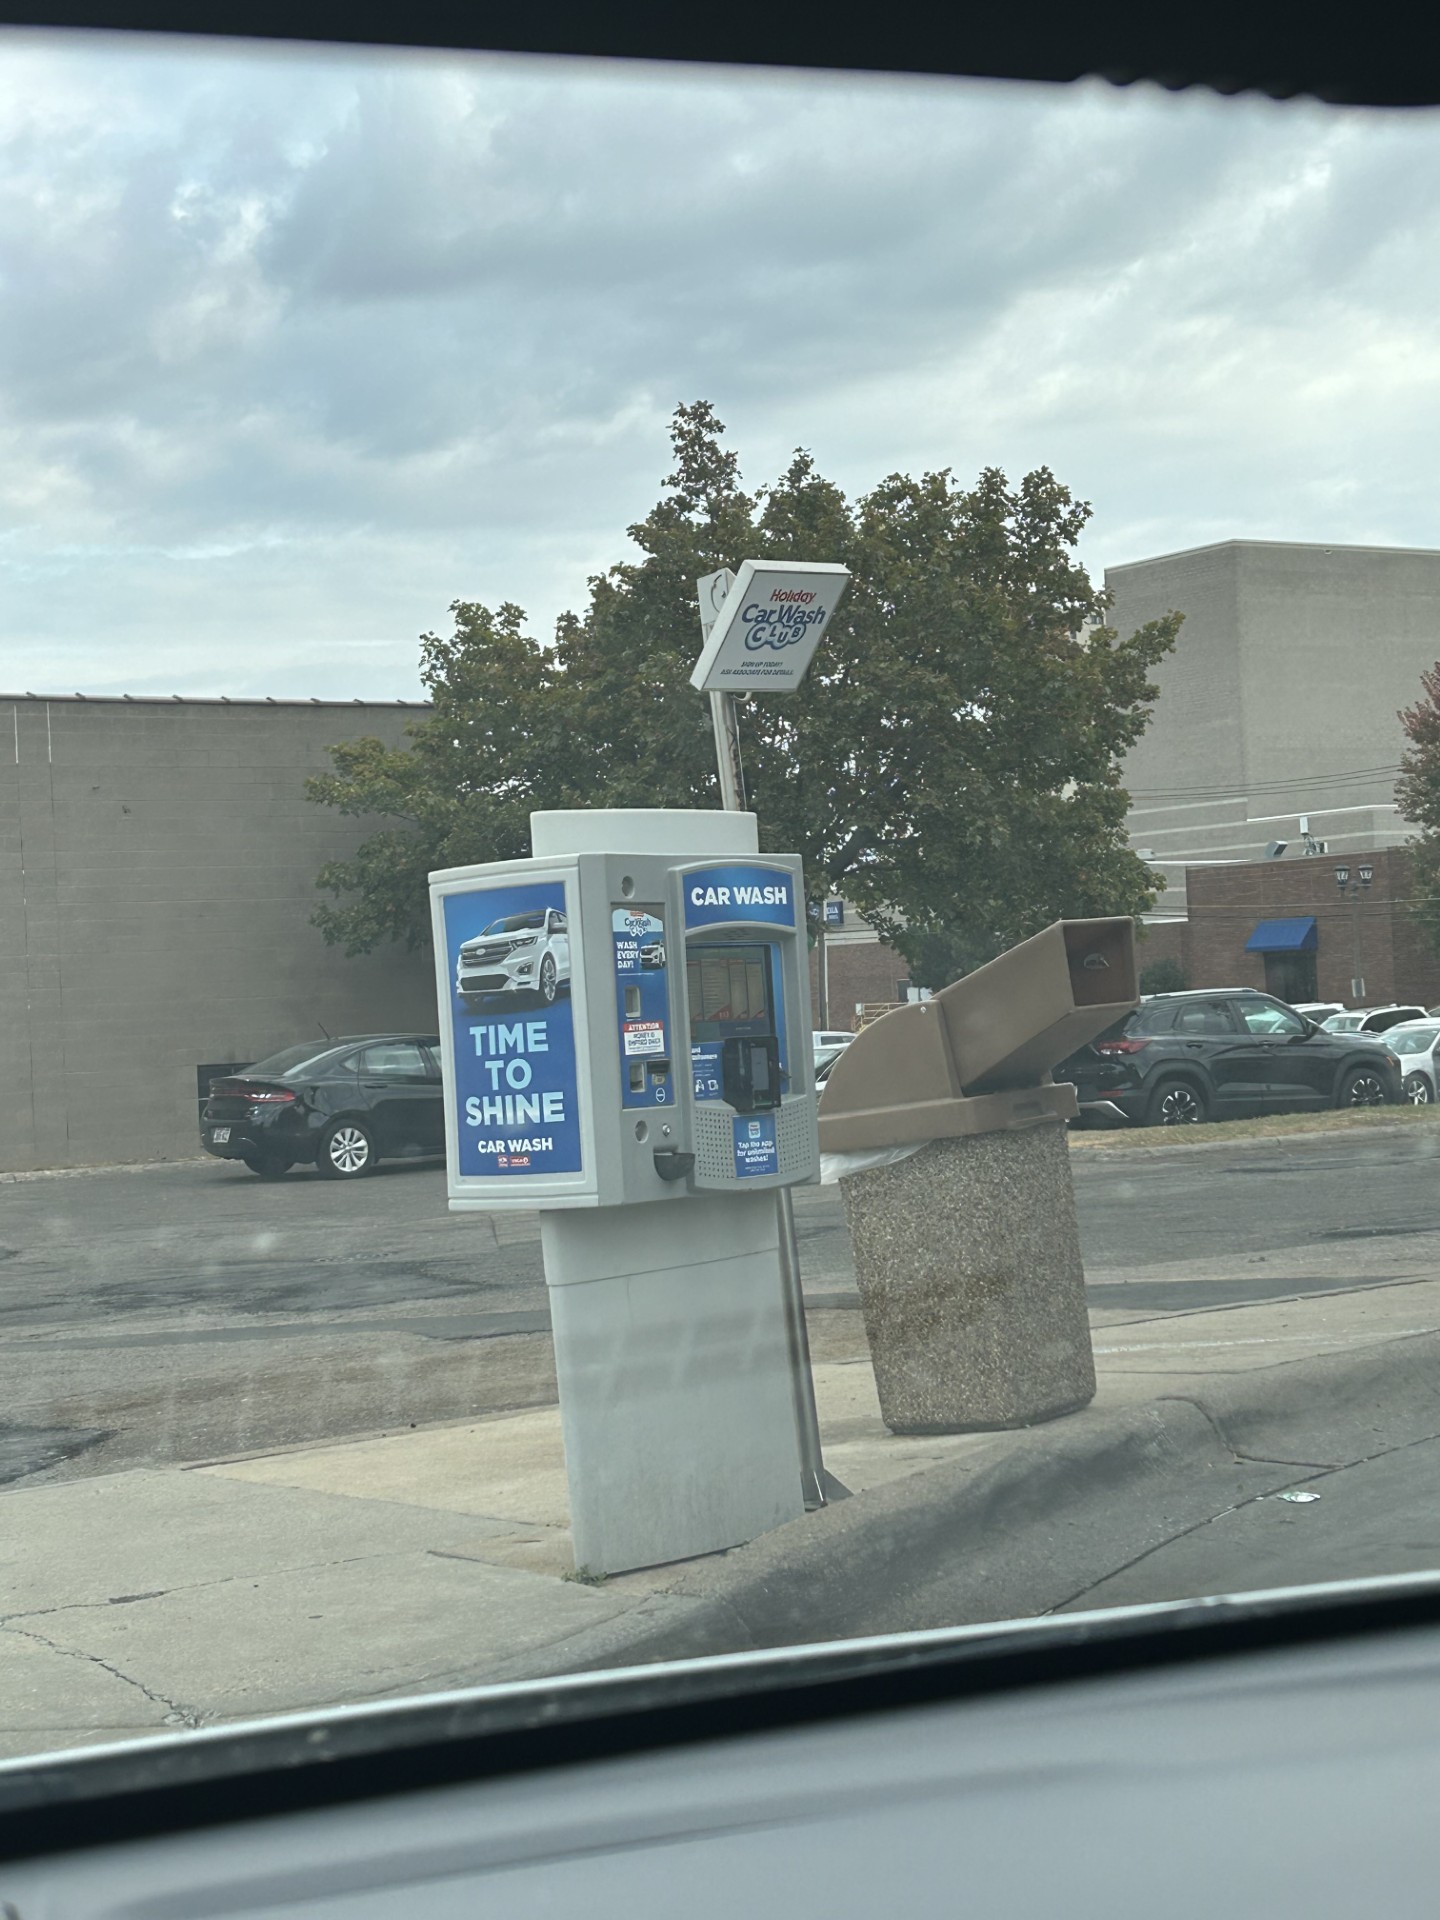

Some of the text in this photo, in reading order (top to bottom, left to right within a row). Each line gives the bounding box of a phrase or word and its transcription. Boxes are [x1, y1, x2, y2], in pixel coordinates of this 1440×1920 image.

[769, 588, 817, 604] Holiday
[691, 886, 787, 906] CAR WASH
[628, 1023, 660, 1031] ATTENTION
[469, 1021, 549, 1056] TIME
[485, 1058, 532, 1091] TO
[465, 1091, 565, 1127] SHINE
[478, 1137, 553, 1154] CAR WASH
